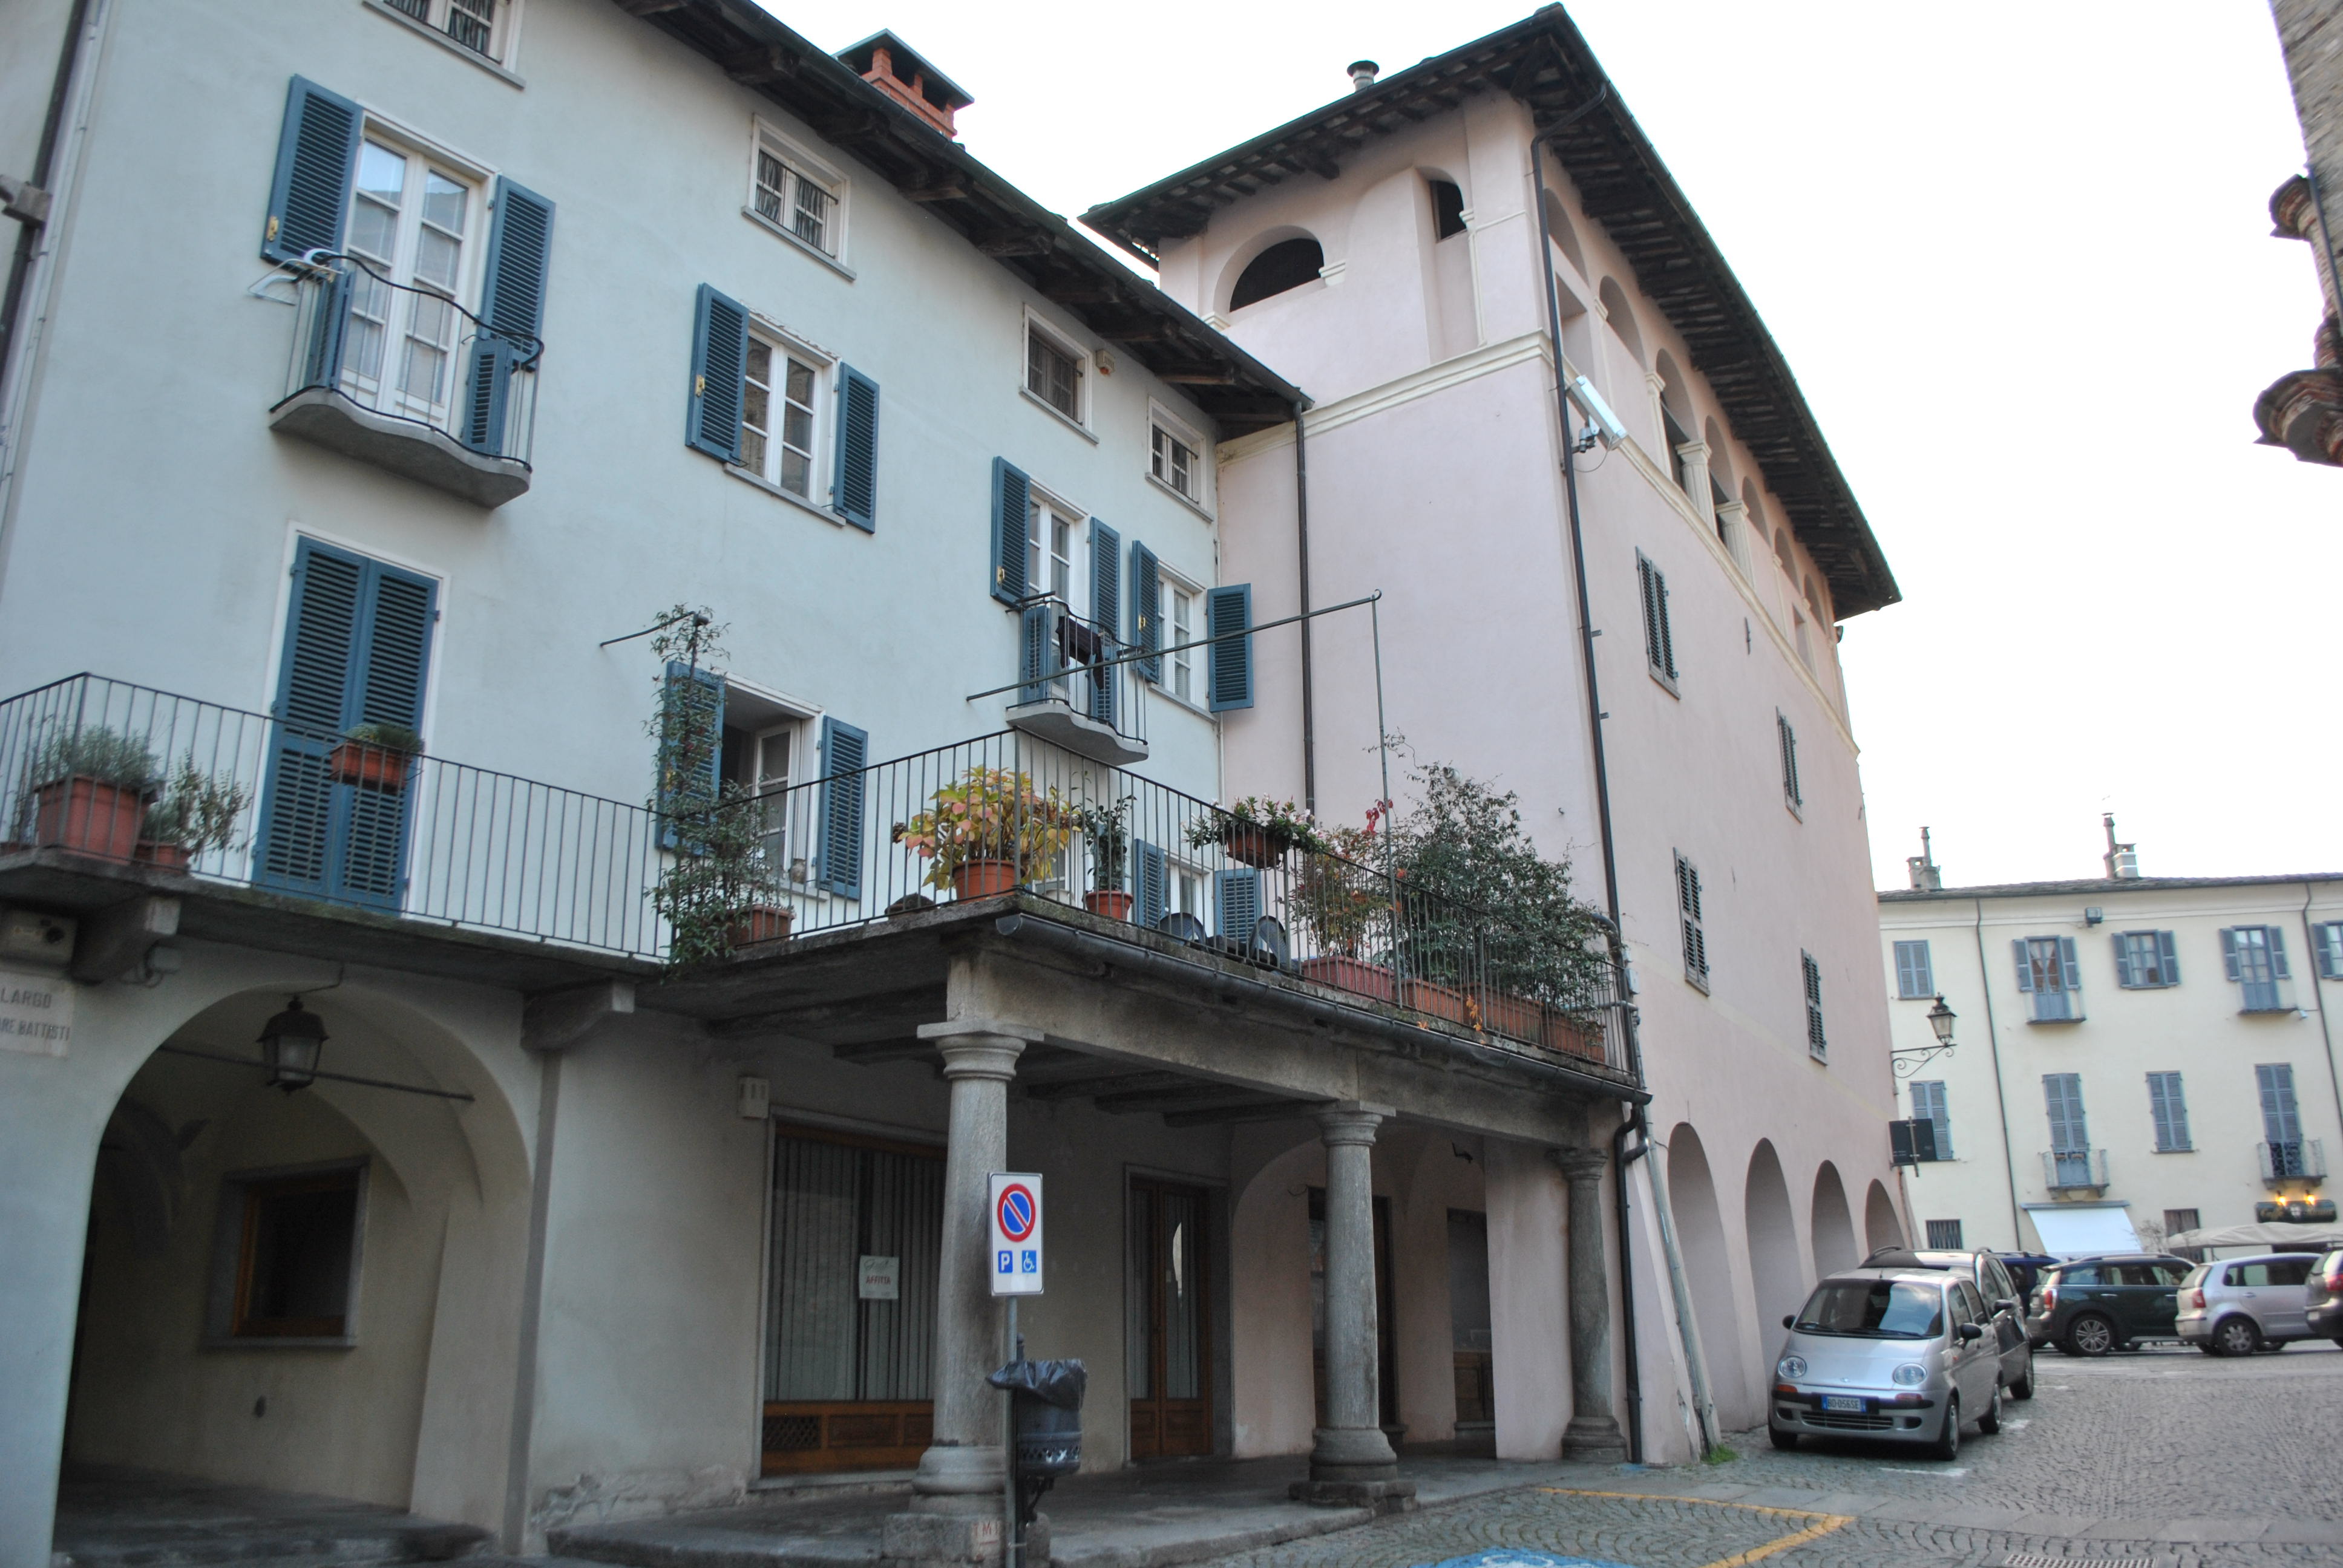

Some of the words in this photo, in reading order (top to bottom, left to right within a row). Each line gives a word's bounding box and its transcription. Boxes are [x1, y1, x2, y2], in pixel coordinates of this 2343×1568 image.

[1, 987, 52, 1008] LARGO
[18, 1020, 70, 1040] BATTISTI
[1001, 1253, 1010, 1272] P
[866, 1275, 891, 1286] AFFITTA
